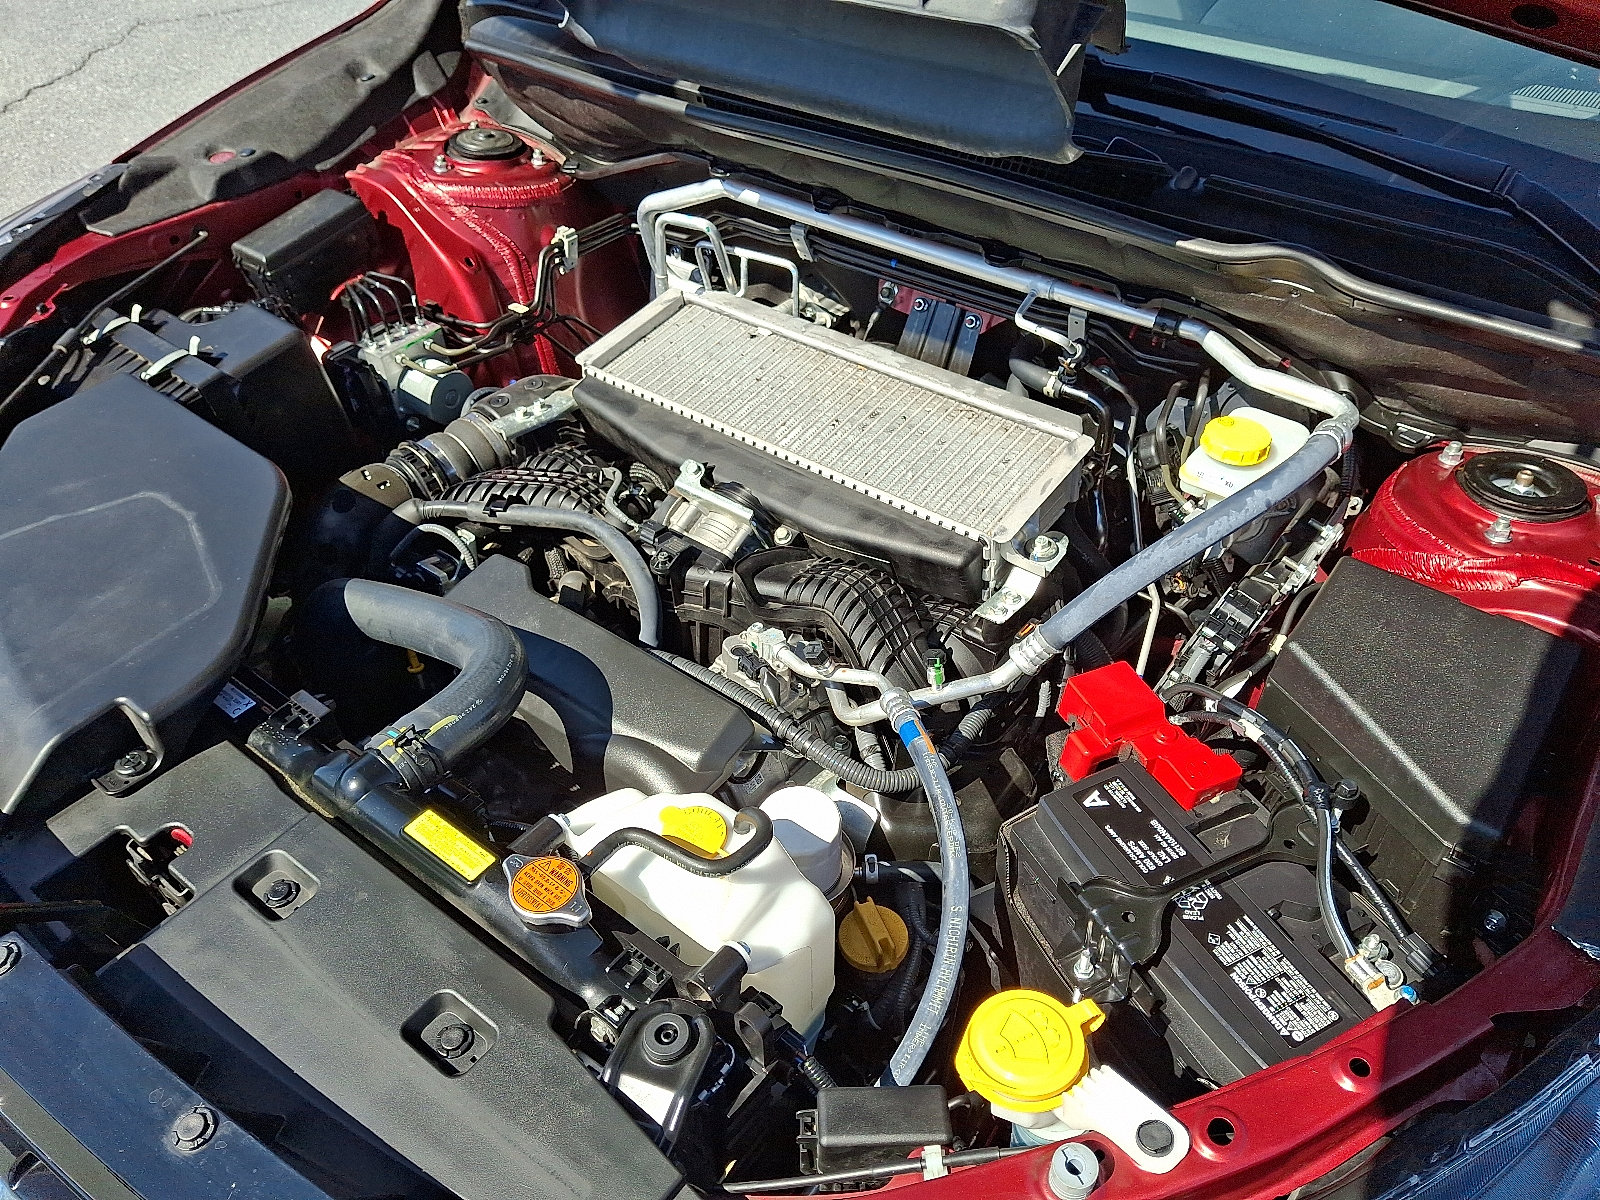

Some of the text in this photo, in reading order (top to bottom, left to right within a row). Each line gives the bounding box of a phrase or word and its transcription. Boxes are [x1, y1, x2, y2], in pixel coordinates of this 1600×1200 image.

[1105, 825, 1148, 873] COLD CRANKING AMPS
[1128, 841, 1146, 858] AMPS
[1138, 840, 1163, 866] GROUP SIZE
[549, 868, 574, 887] WARNING
[942, 918, 961, 965] NICHIRIN
